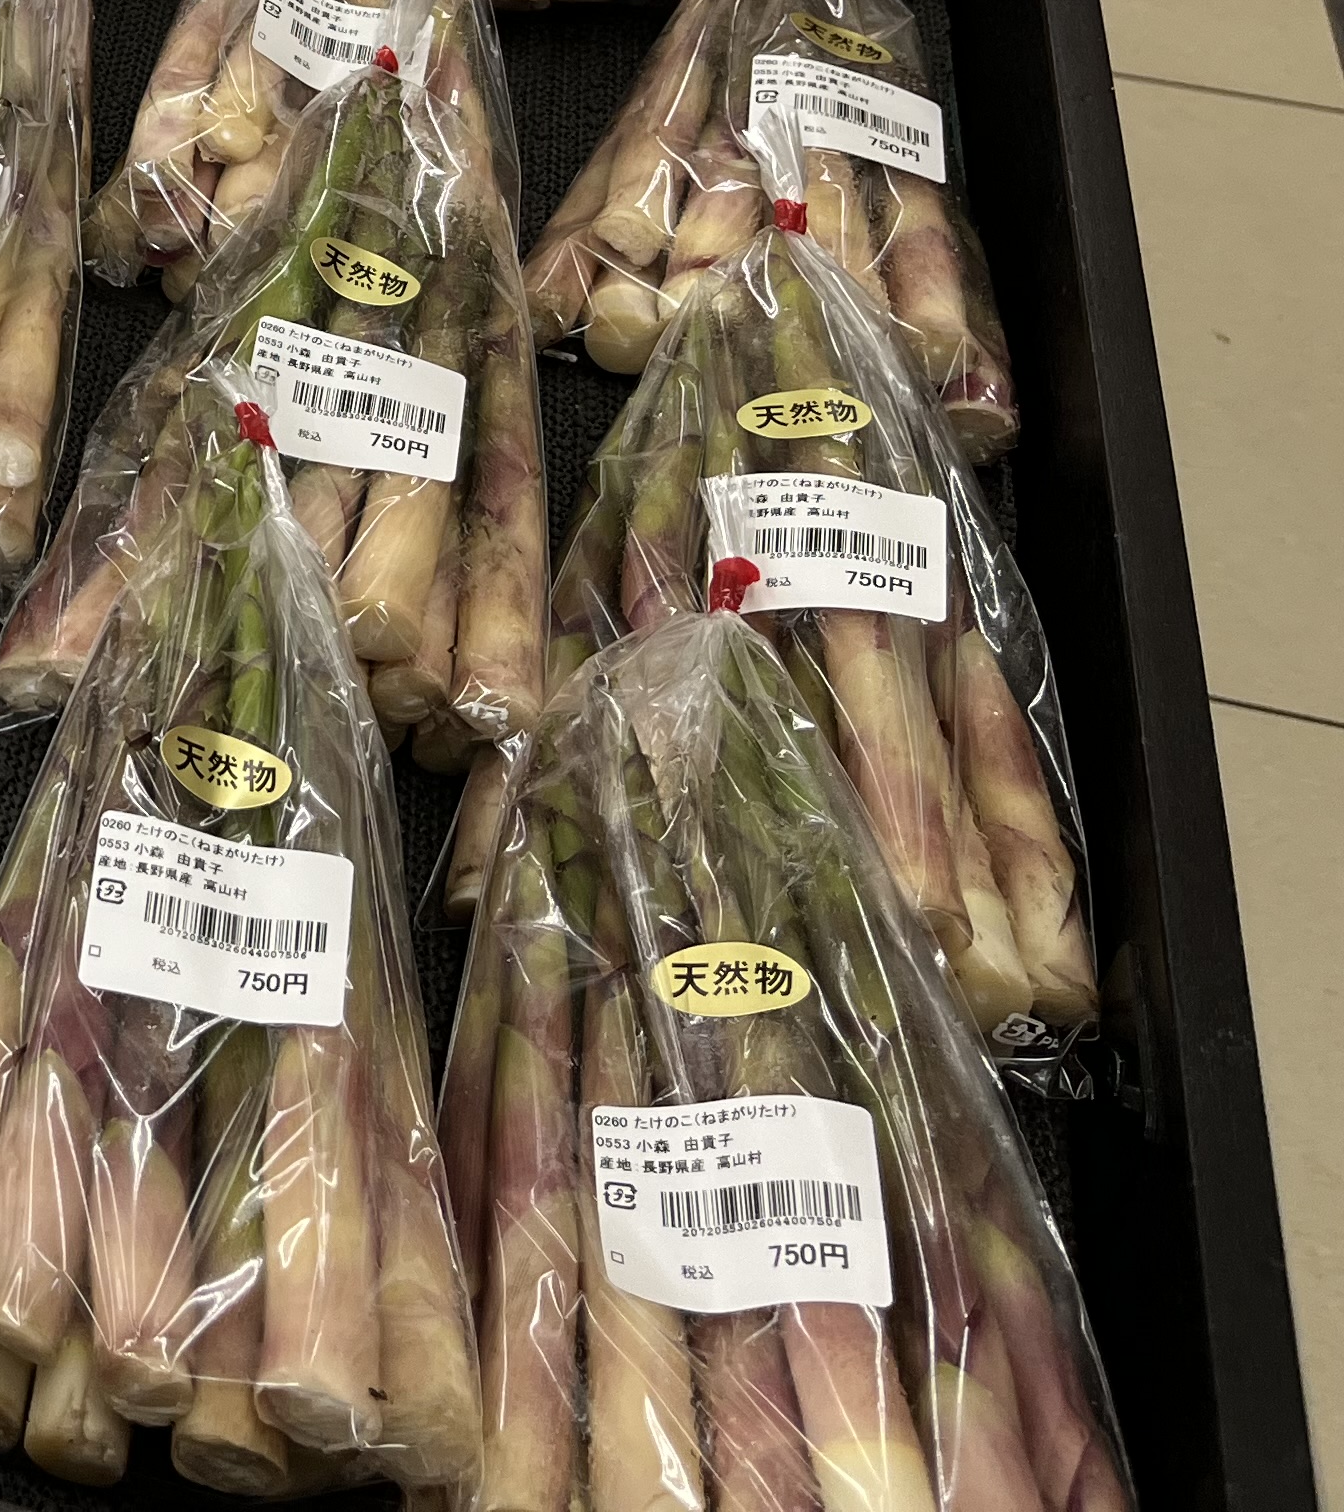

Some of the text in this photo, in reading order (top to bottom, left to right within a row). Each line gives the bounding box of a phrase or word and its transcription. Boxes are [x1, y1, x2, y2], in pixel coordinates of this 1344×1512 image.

[802, 18, 883, 61] 天然物
[868, 135, 921, 163] 750円
[319, 242, 408, 298] 天然物
[261, 320, 286, 335] 0260
[258, 335, 362, 368] 0553 小森 由貴子
[343, 369, 382, 386] 高山村
[752, 399, 858, 429] 天然物
[297, 428, 429, 459] 税込 750円
[780, 492, 826, 504] 由貴子
[807, 506, 851, 520] 高山村
[765, 570, 913, 596] 税込 750円
[175, 736, 277, 794] 天然物
[102, 817, 132, 832] 0260
[98, 837, 224, 876] 0553 小森 由貴子
[203, 877, 248, 901] 高山村
[151, 957, 309, 995] 税込 750円
[672, 960, 794, 998] 天然物
[594, 1104, 797, 1130] 0260 たけのこ(ねまがりたけ)
[596, 1133, 734, 1153] 0553 小森 由貴子
[716, 1150, 763, 1170] 高山村
[681, 1241, 850, 1280] 税込 750円
